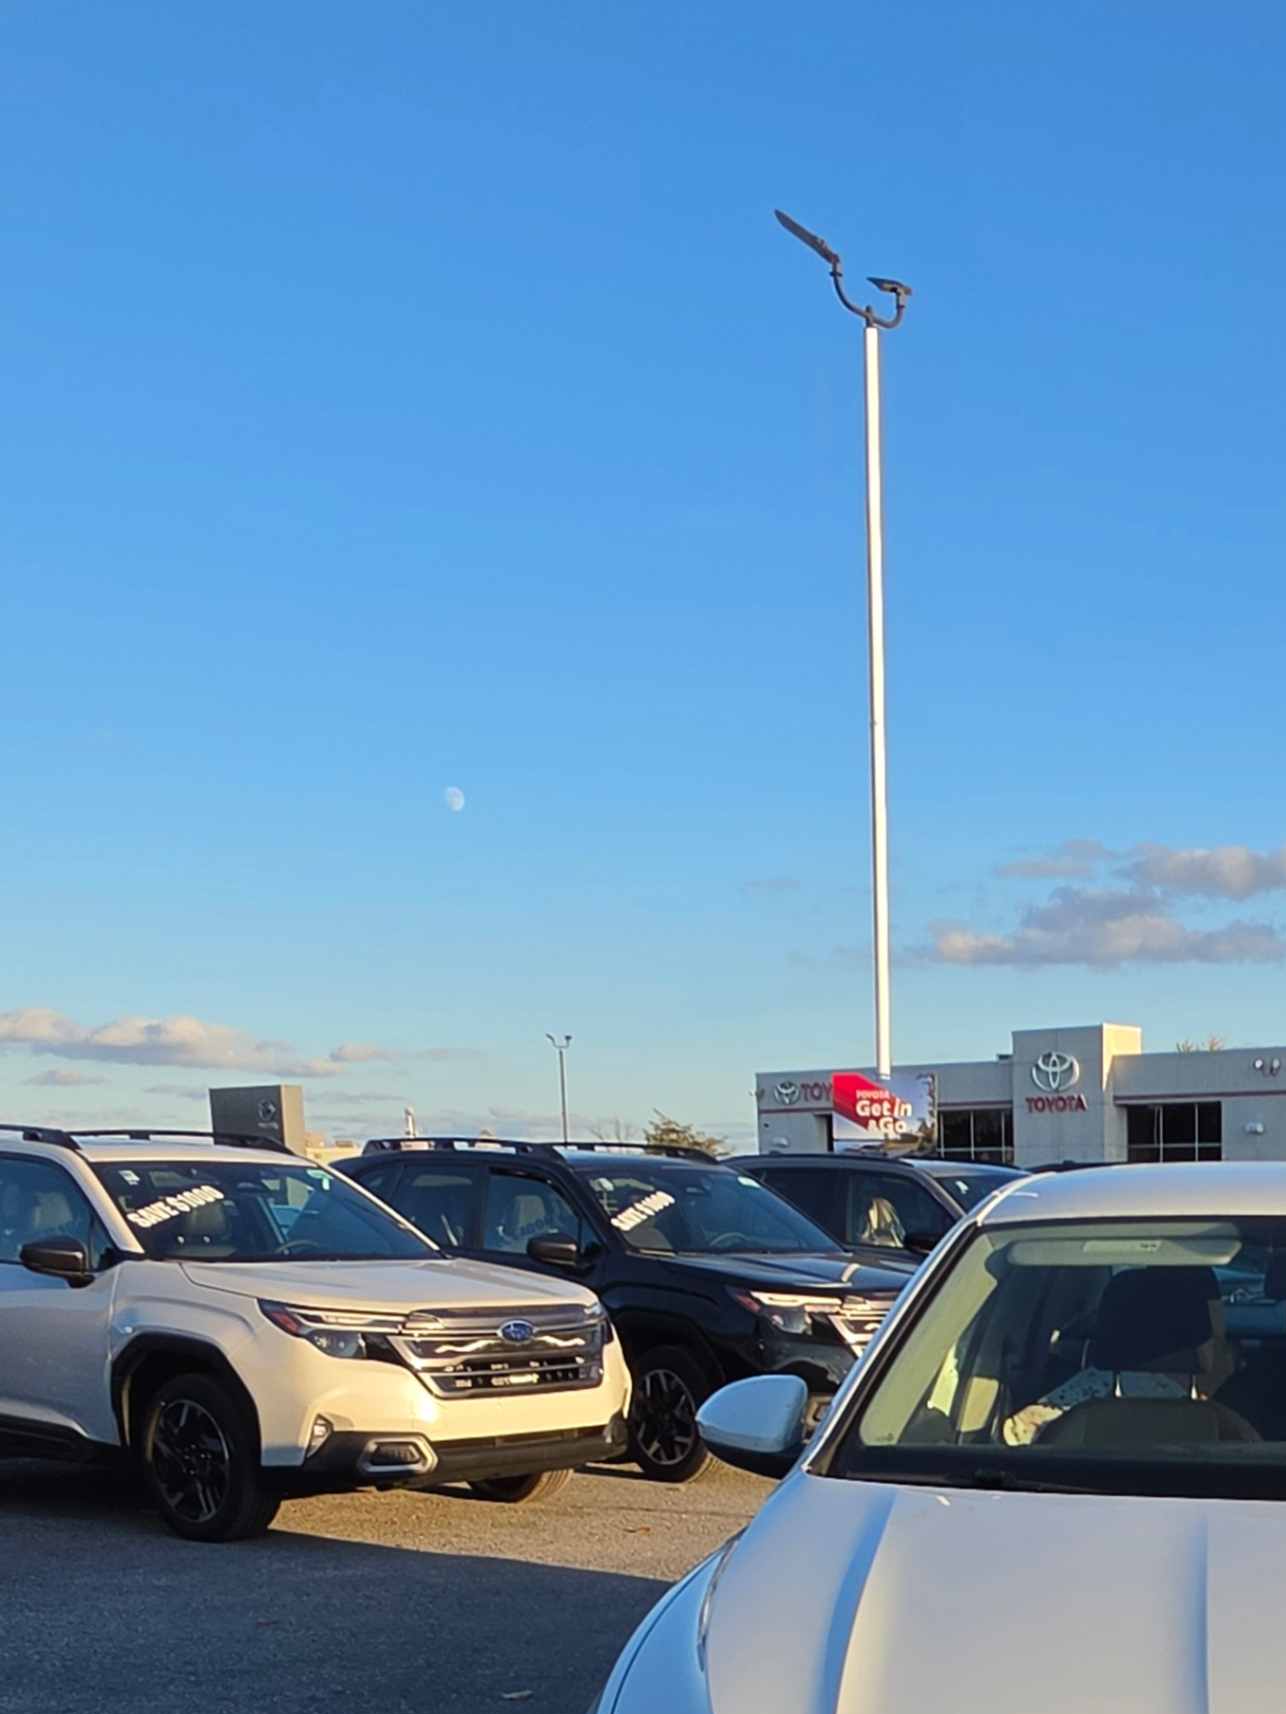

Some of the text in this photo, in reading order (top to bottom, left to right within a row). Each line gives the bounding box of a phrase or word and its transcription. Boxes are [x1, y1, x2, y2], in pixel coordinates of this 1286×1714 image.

[801, 1082, 833, 1103] TOY
[856, 1099, 892, 1118] Get
[1025, 1094, 1088, 1114] TOYOTA
[126, 1201, 180, 1228] SAVE
[610, 1207, 648, 1231] SAVE
